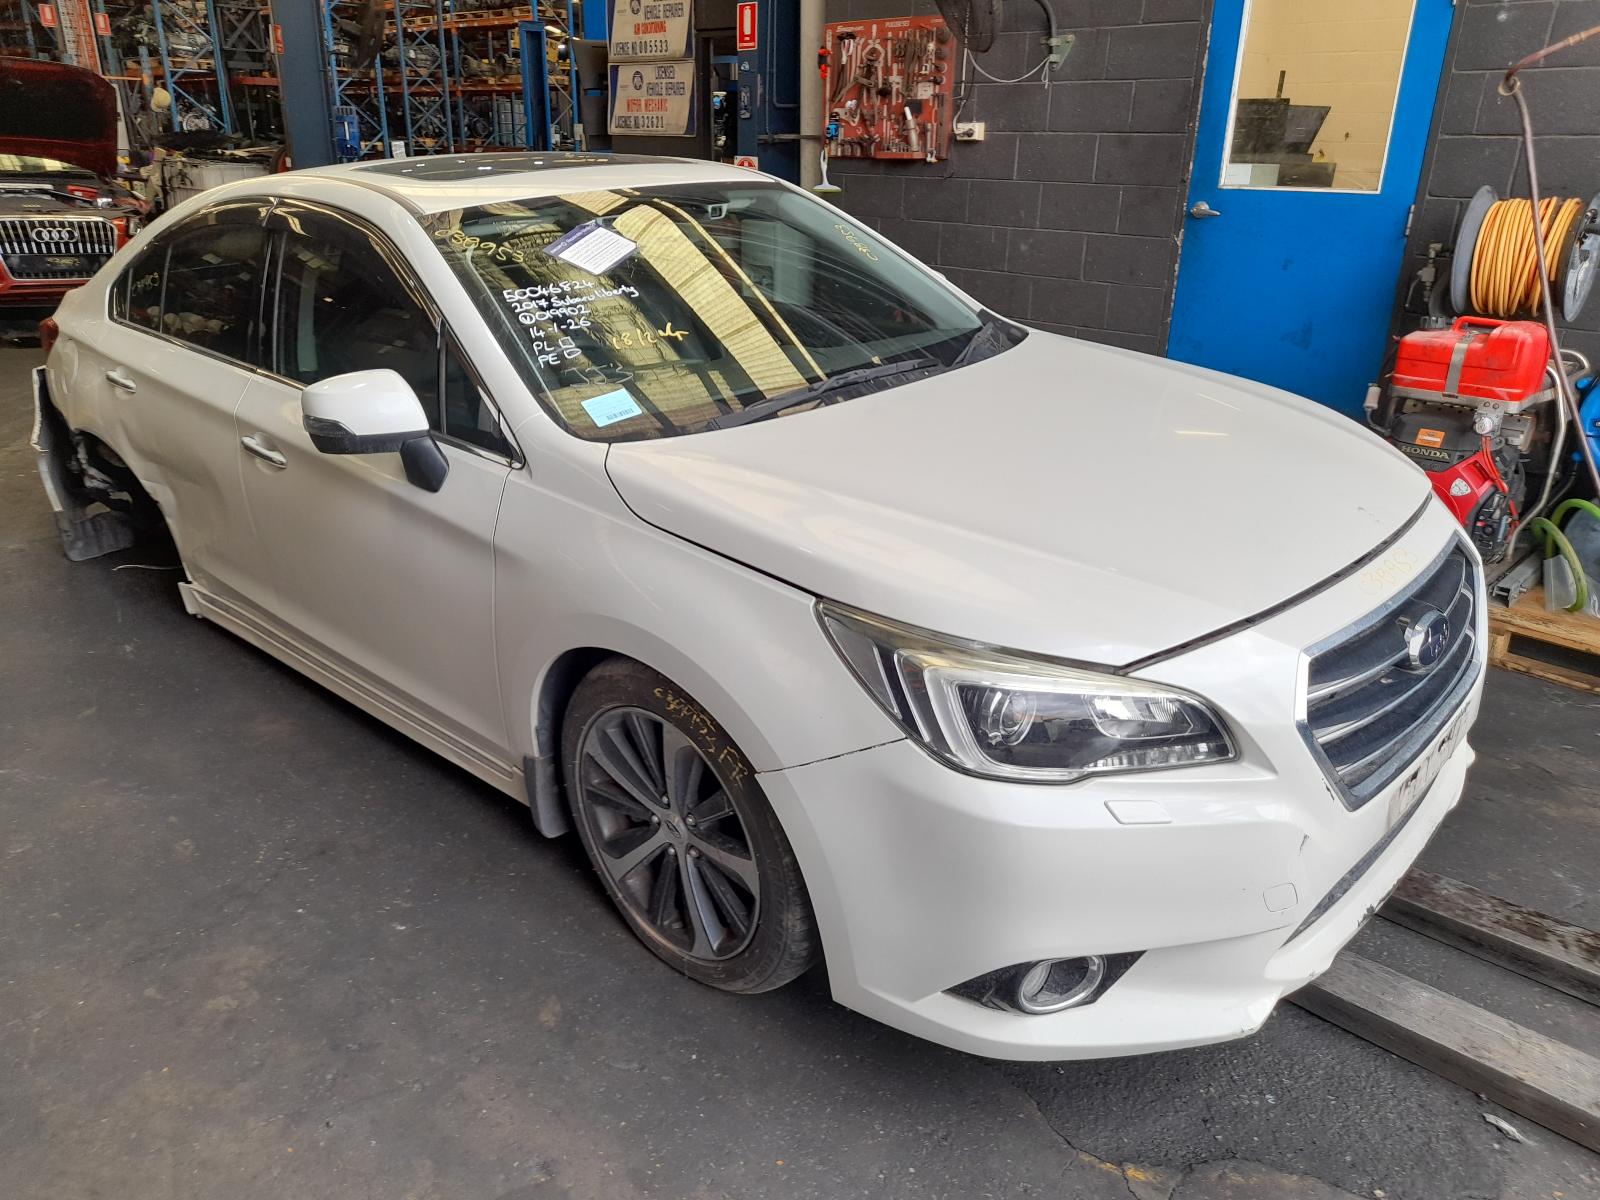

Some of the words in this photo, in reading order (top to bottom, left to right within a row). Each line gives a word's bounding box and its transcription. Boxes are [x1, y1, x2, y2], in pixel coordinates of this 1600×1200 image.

[639, 39, 669, 54] 005533
[641, 115, 664, 129] 32621
[502, 279, 595, 302] 50046824
[512, 298, 548, 313] 2017
[532, 341, 555, 356] PL
[537, 352, 561, 369] PE
[1400, 444, 1451, 461] HONDA
